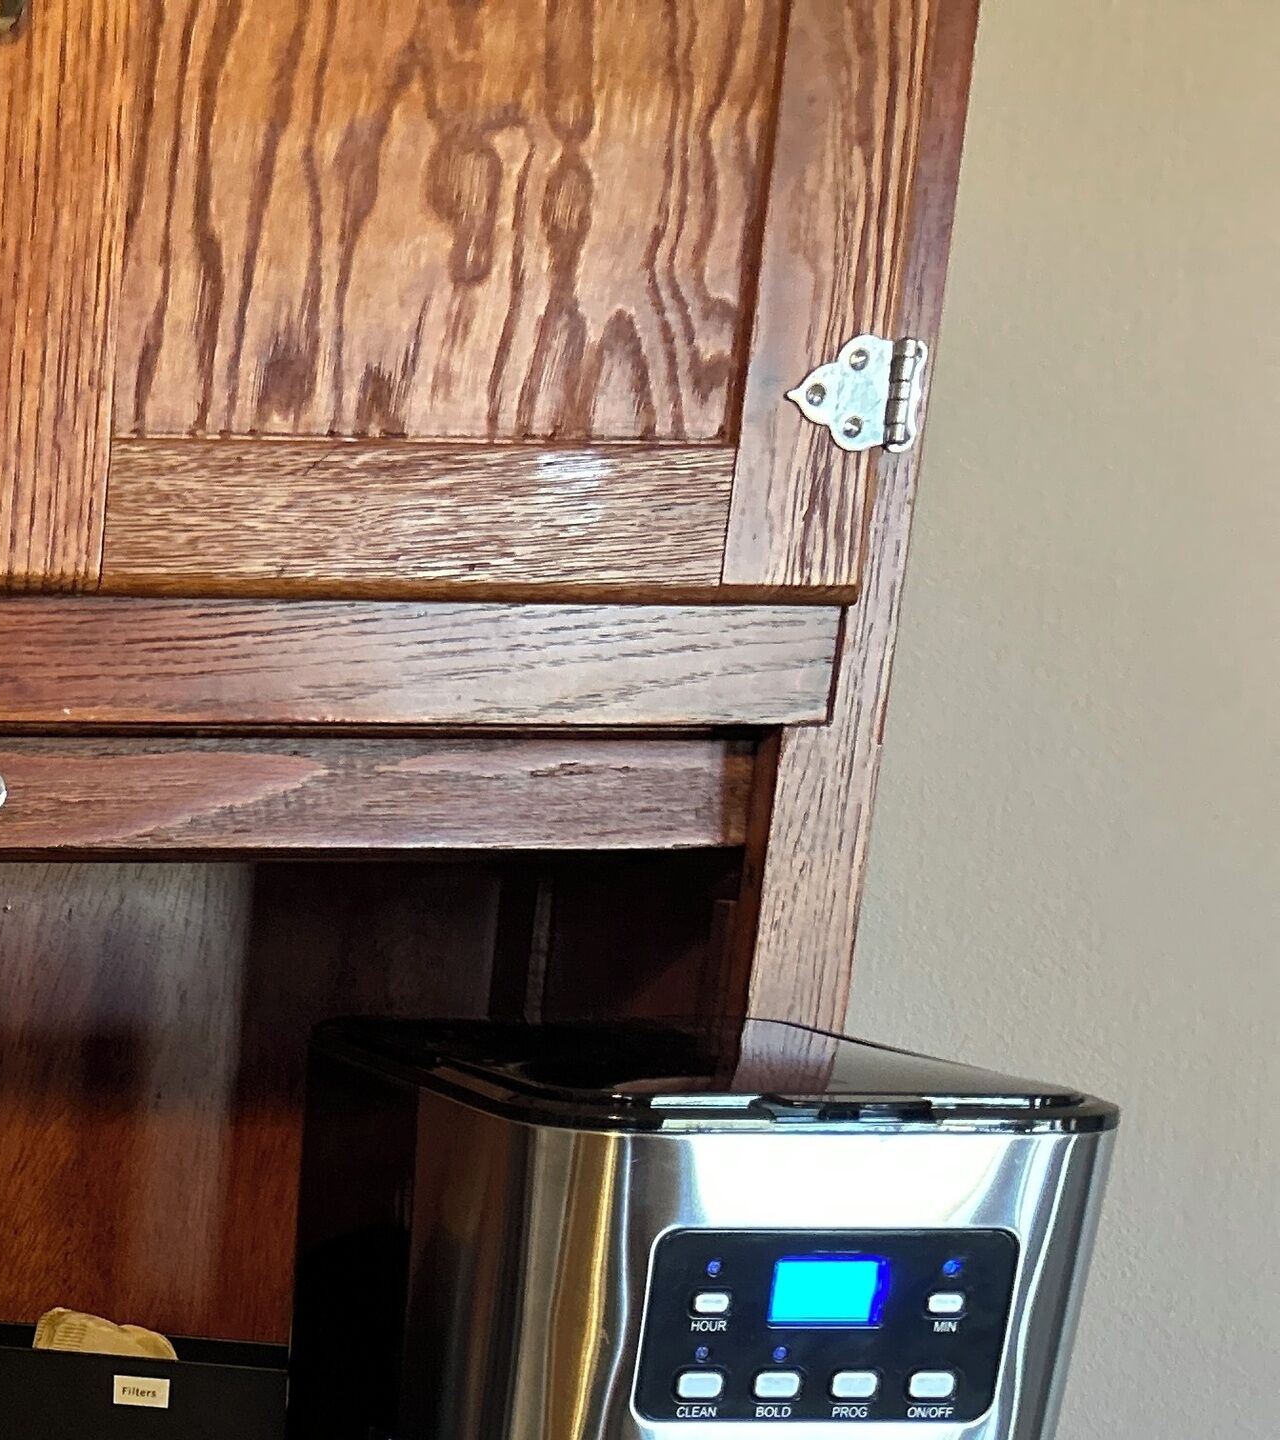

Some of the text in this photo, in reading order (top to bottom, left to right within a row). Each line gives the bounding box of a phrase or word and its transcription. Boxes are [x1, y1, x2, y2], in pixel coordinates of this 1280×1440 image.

[690, 1320, 727, 1333] HOUR
[933, 1321, 958, 1333] MIN
[121, 1386, 157, 1399] Filters
[676, 1405, 954, 1418] CLEAN BOLD PROG ON/OFF
